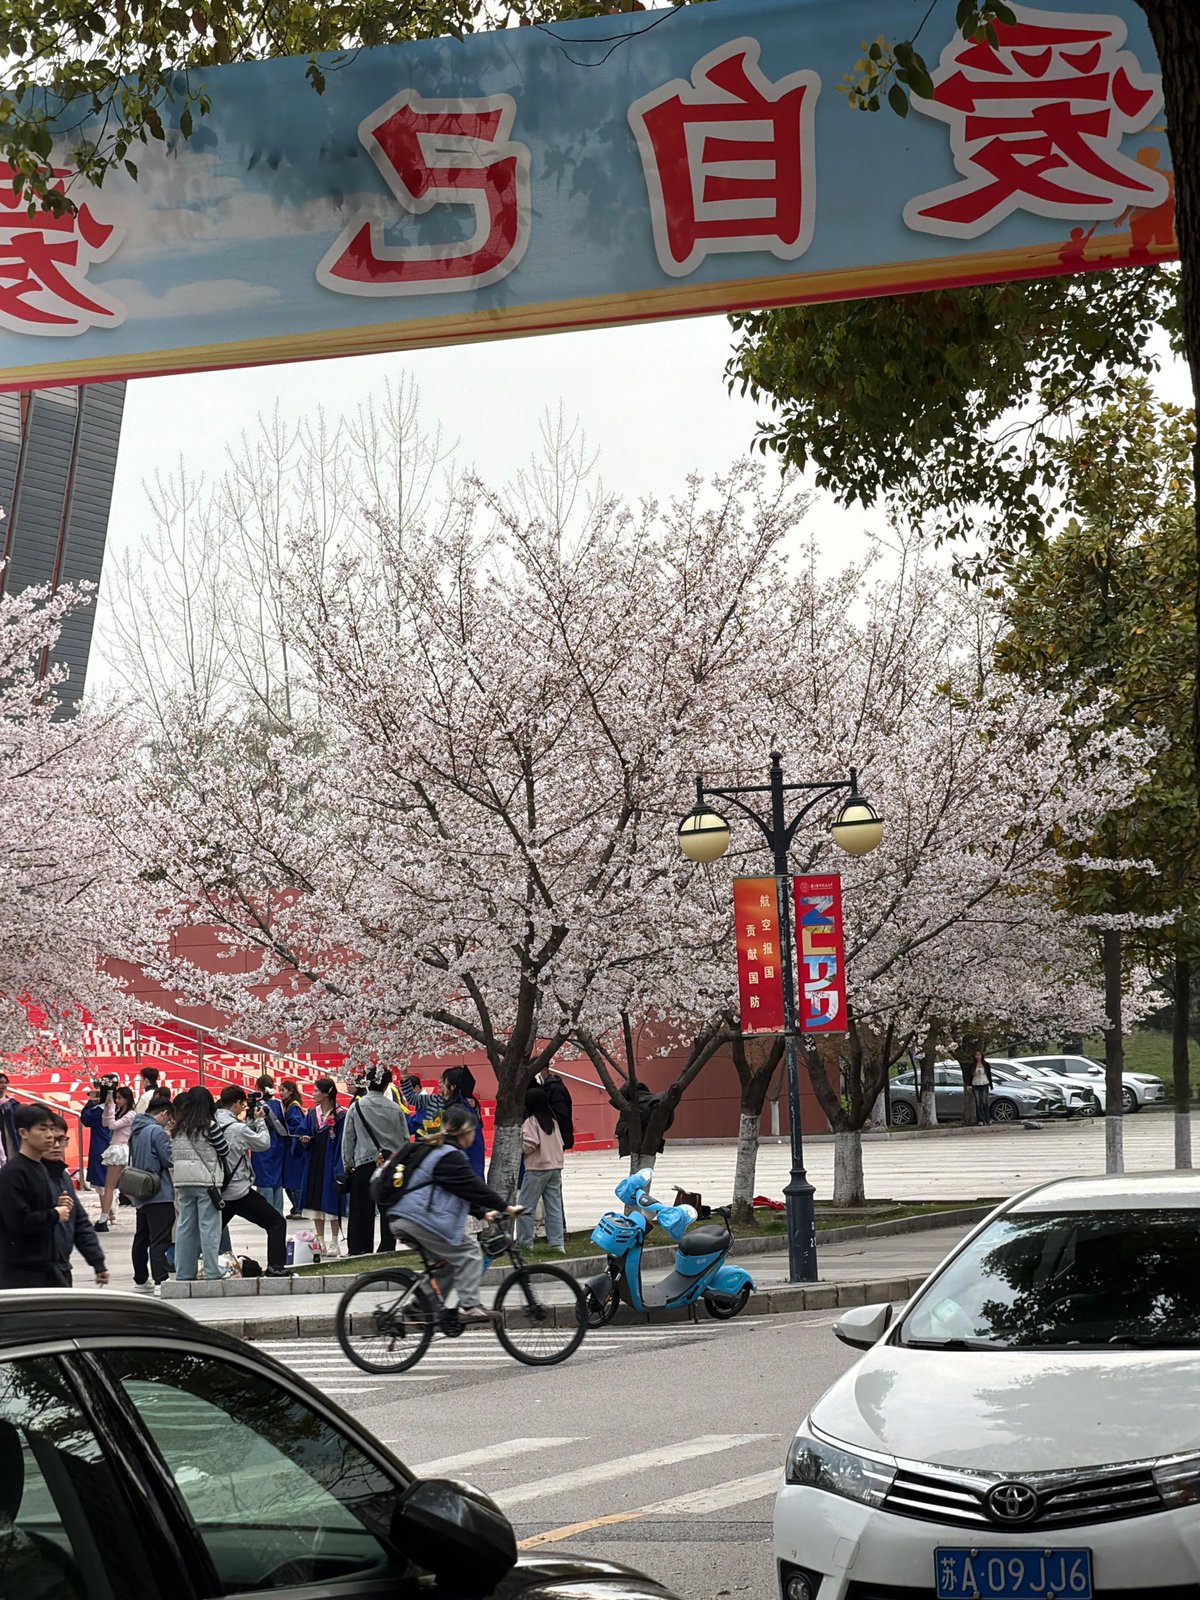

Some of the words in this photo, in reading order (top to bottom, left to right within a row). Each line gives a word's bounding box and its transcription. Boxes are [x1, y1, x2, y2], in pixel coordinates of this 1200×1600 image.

[745, 924, 760, 1009] 贡献国防
[759, 894, 775, 979] 航空报国
[940, 1556, 1087, 1592] 苏A·09JJ6
